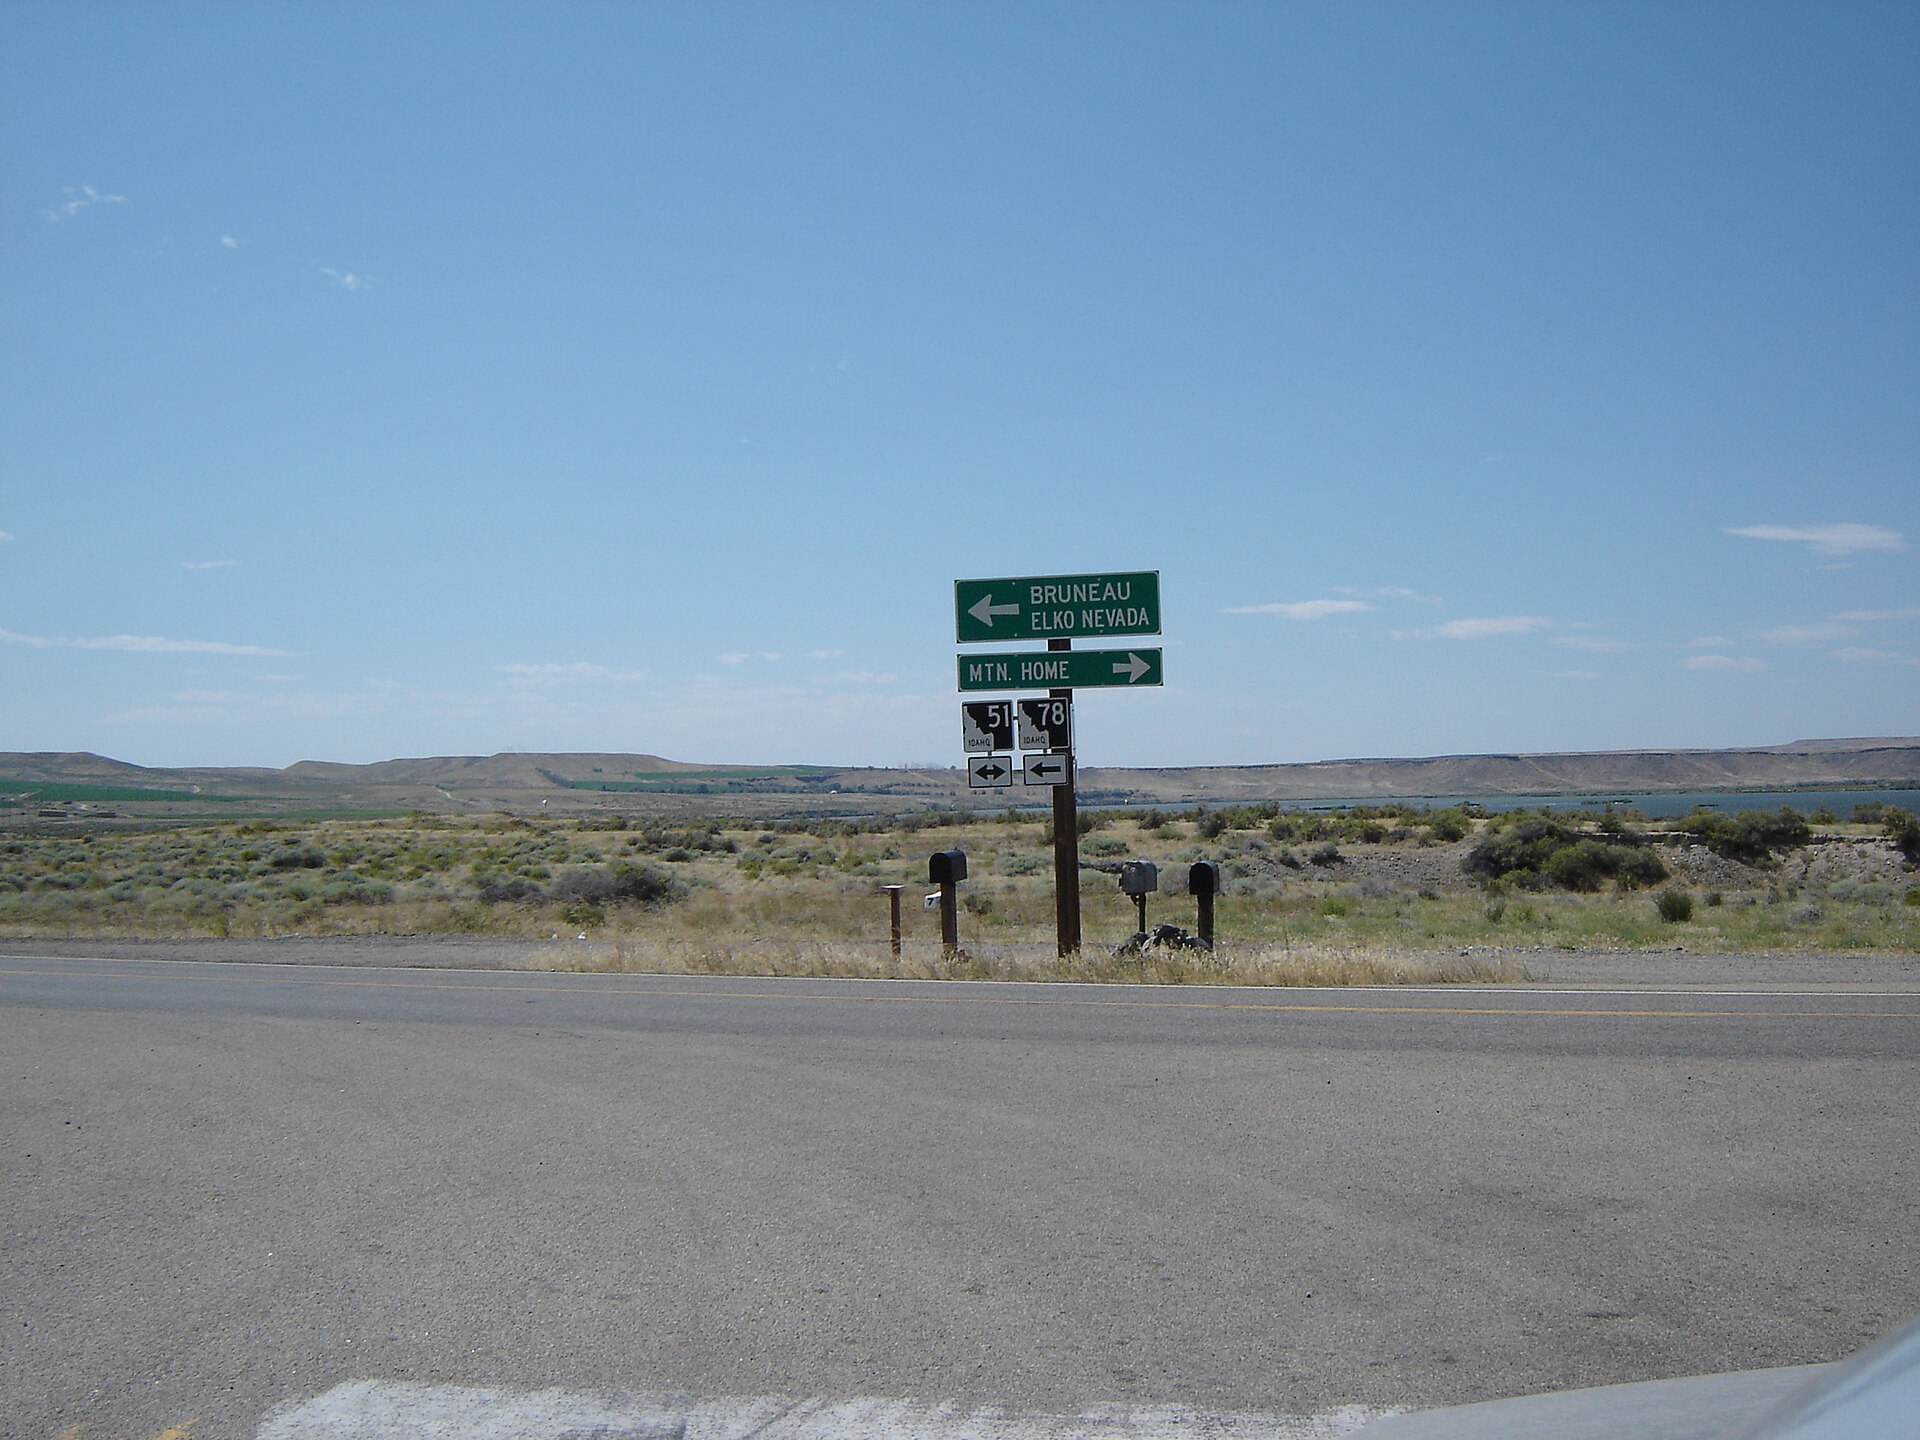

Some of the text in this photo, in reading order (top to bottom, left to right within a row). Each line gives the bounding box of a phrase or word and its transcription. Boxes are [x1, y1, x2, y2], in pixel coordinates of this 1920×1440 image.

[1030, 581, 1131, 605] BRUNEAU
[1031, 607, 1150, 631] ELKO NEVADA
[969, 660, 1070, 682] MTN. HOME
[987, 704, 1010, 728] 51
[1037, 702, 1065, 726] 78
